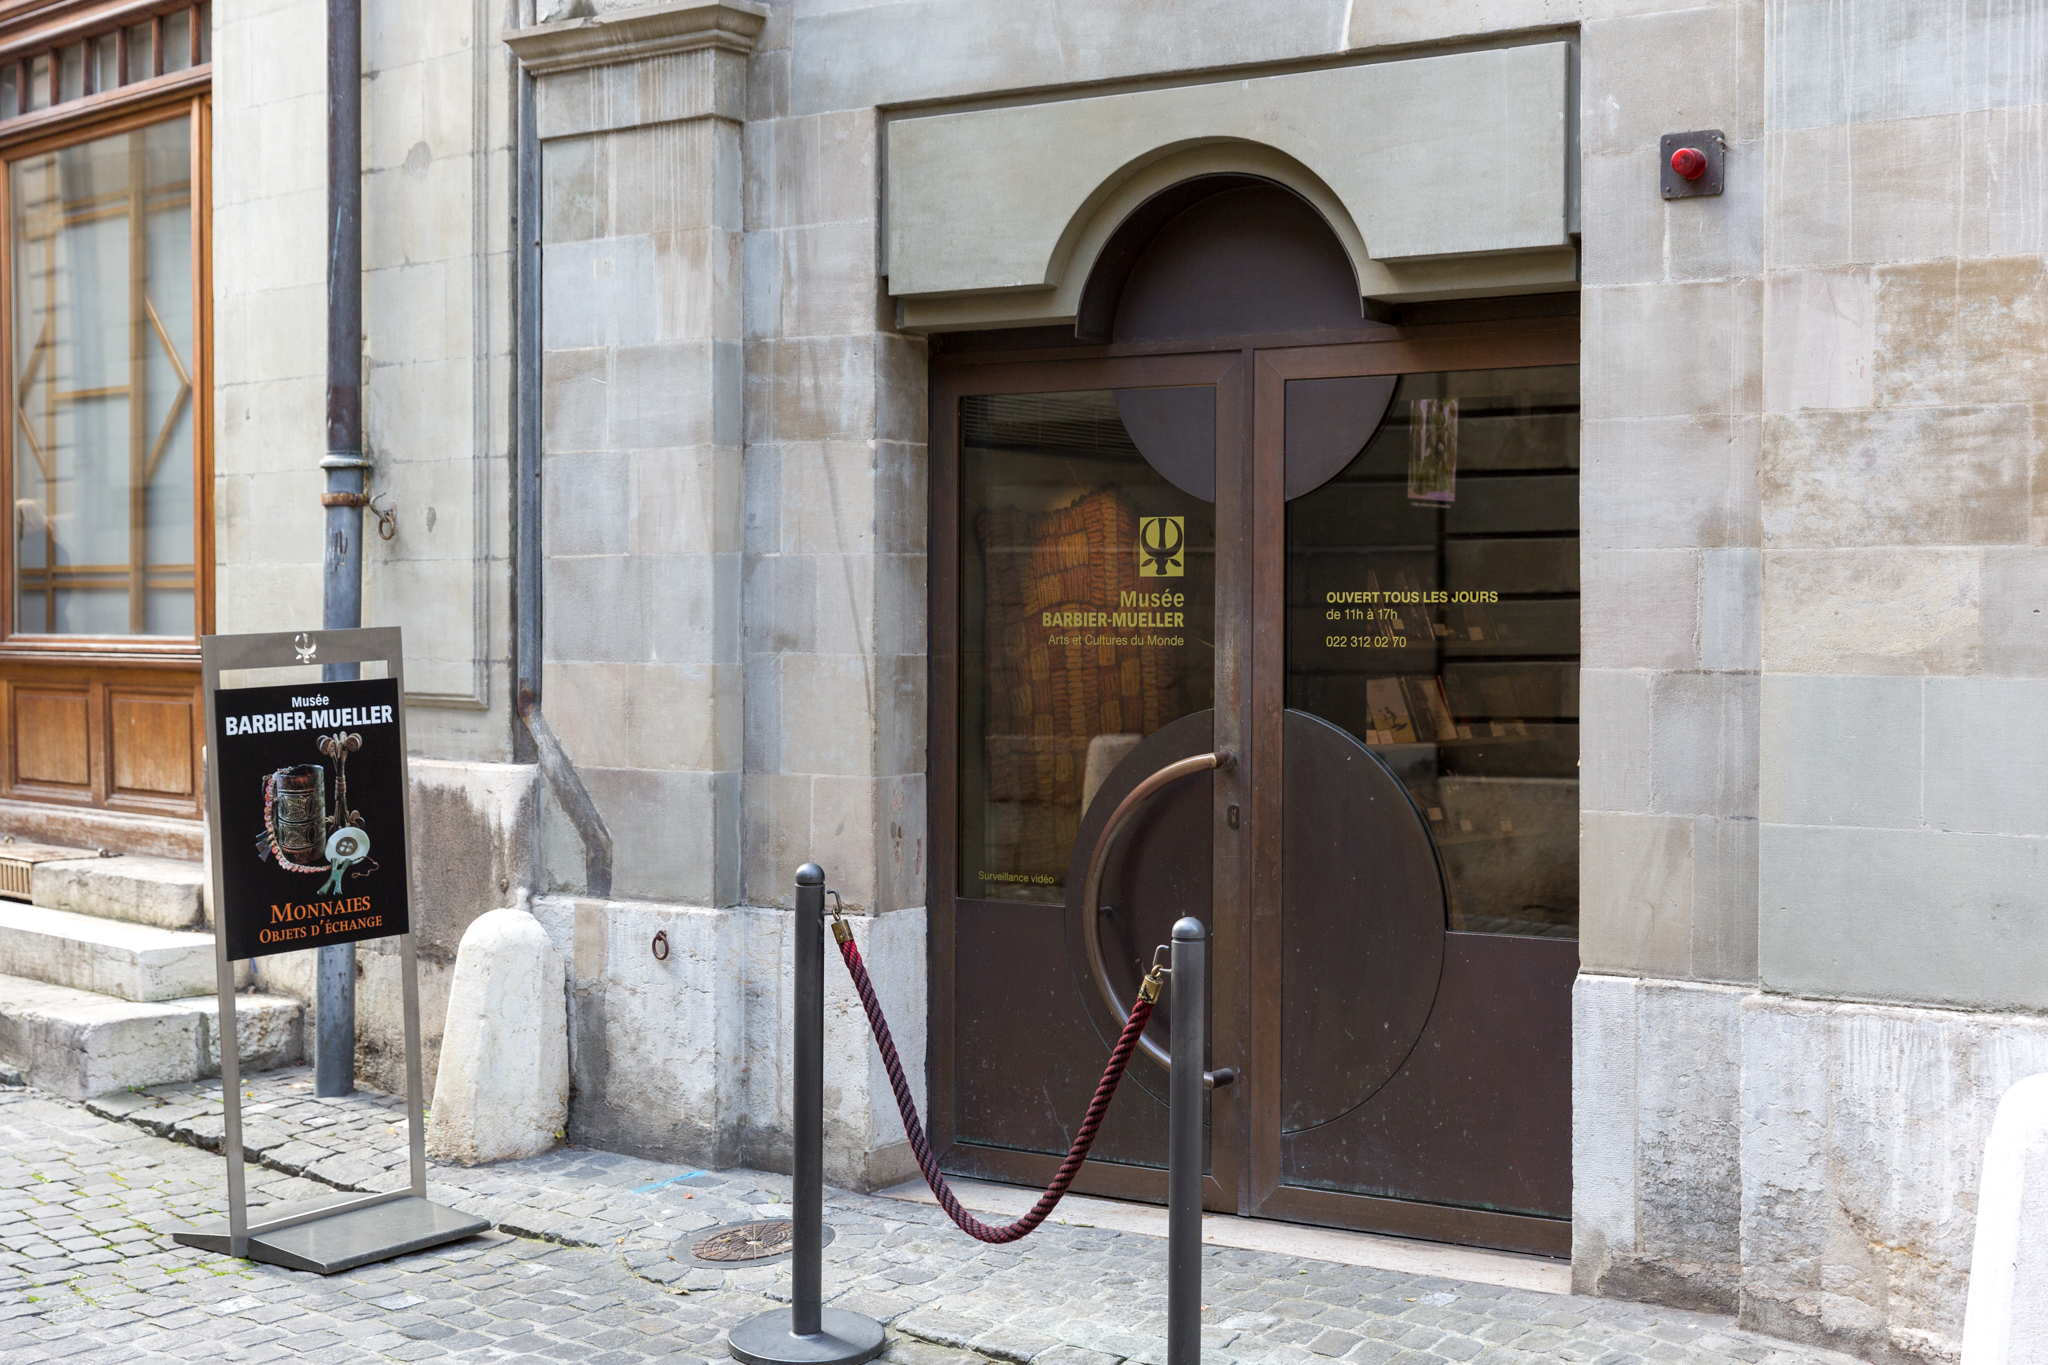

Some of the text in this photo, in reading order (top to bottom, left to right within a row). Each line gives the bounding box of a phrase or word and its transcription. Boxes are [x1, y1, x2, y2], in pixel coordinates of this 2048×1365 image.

[1120, 589, 1185, 608] Musée
[1326, 590, 1499, 603] OUVERT TOUS LES JOURS
[1042, 611, 1184, 628] BARBIER-MUELLER
[1326, 608, 1398, 620] de 11h à 17h
[1048, 634, 1184, 646] Arts et Cultures du Monde
[1326, 635, 1407, 648] 022 312 02 70
[291, 693, 330, 708] Musée
[225, 705, 393, 735] BARBIER-MUELLER
[978, 871, 1055, 884] Surveillance vidéo
[270, 895, 371, 924] MONNAIES
[259, 925, 307, 944] OBJETS
